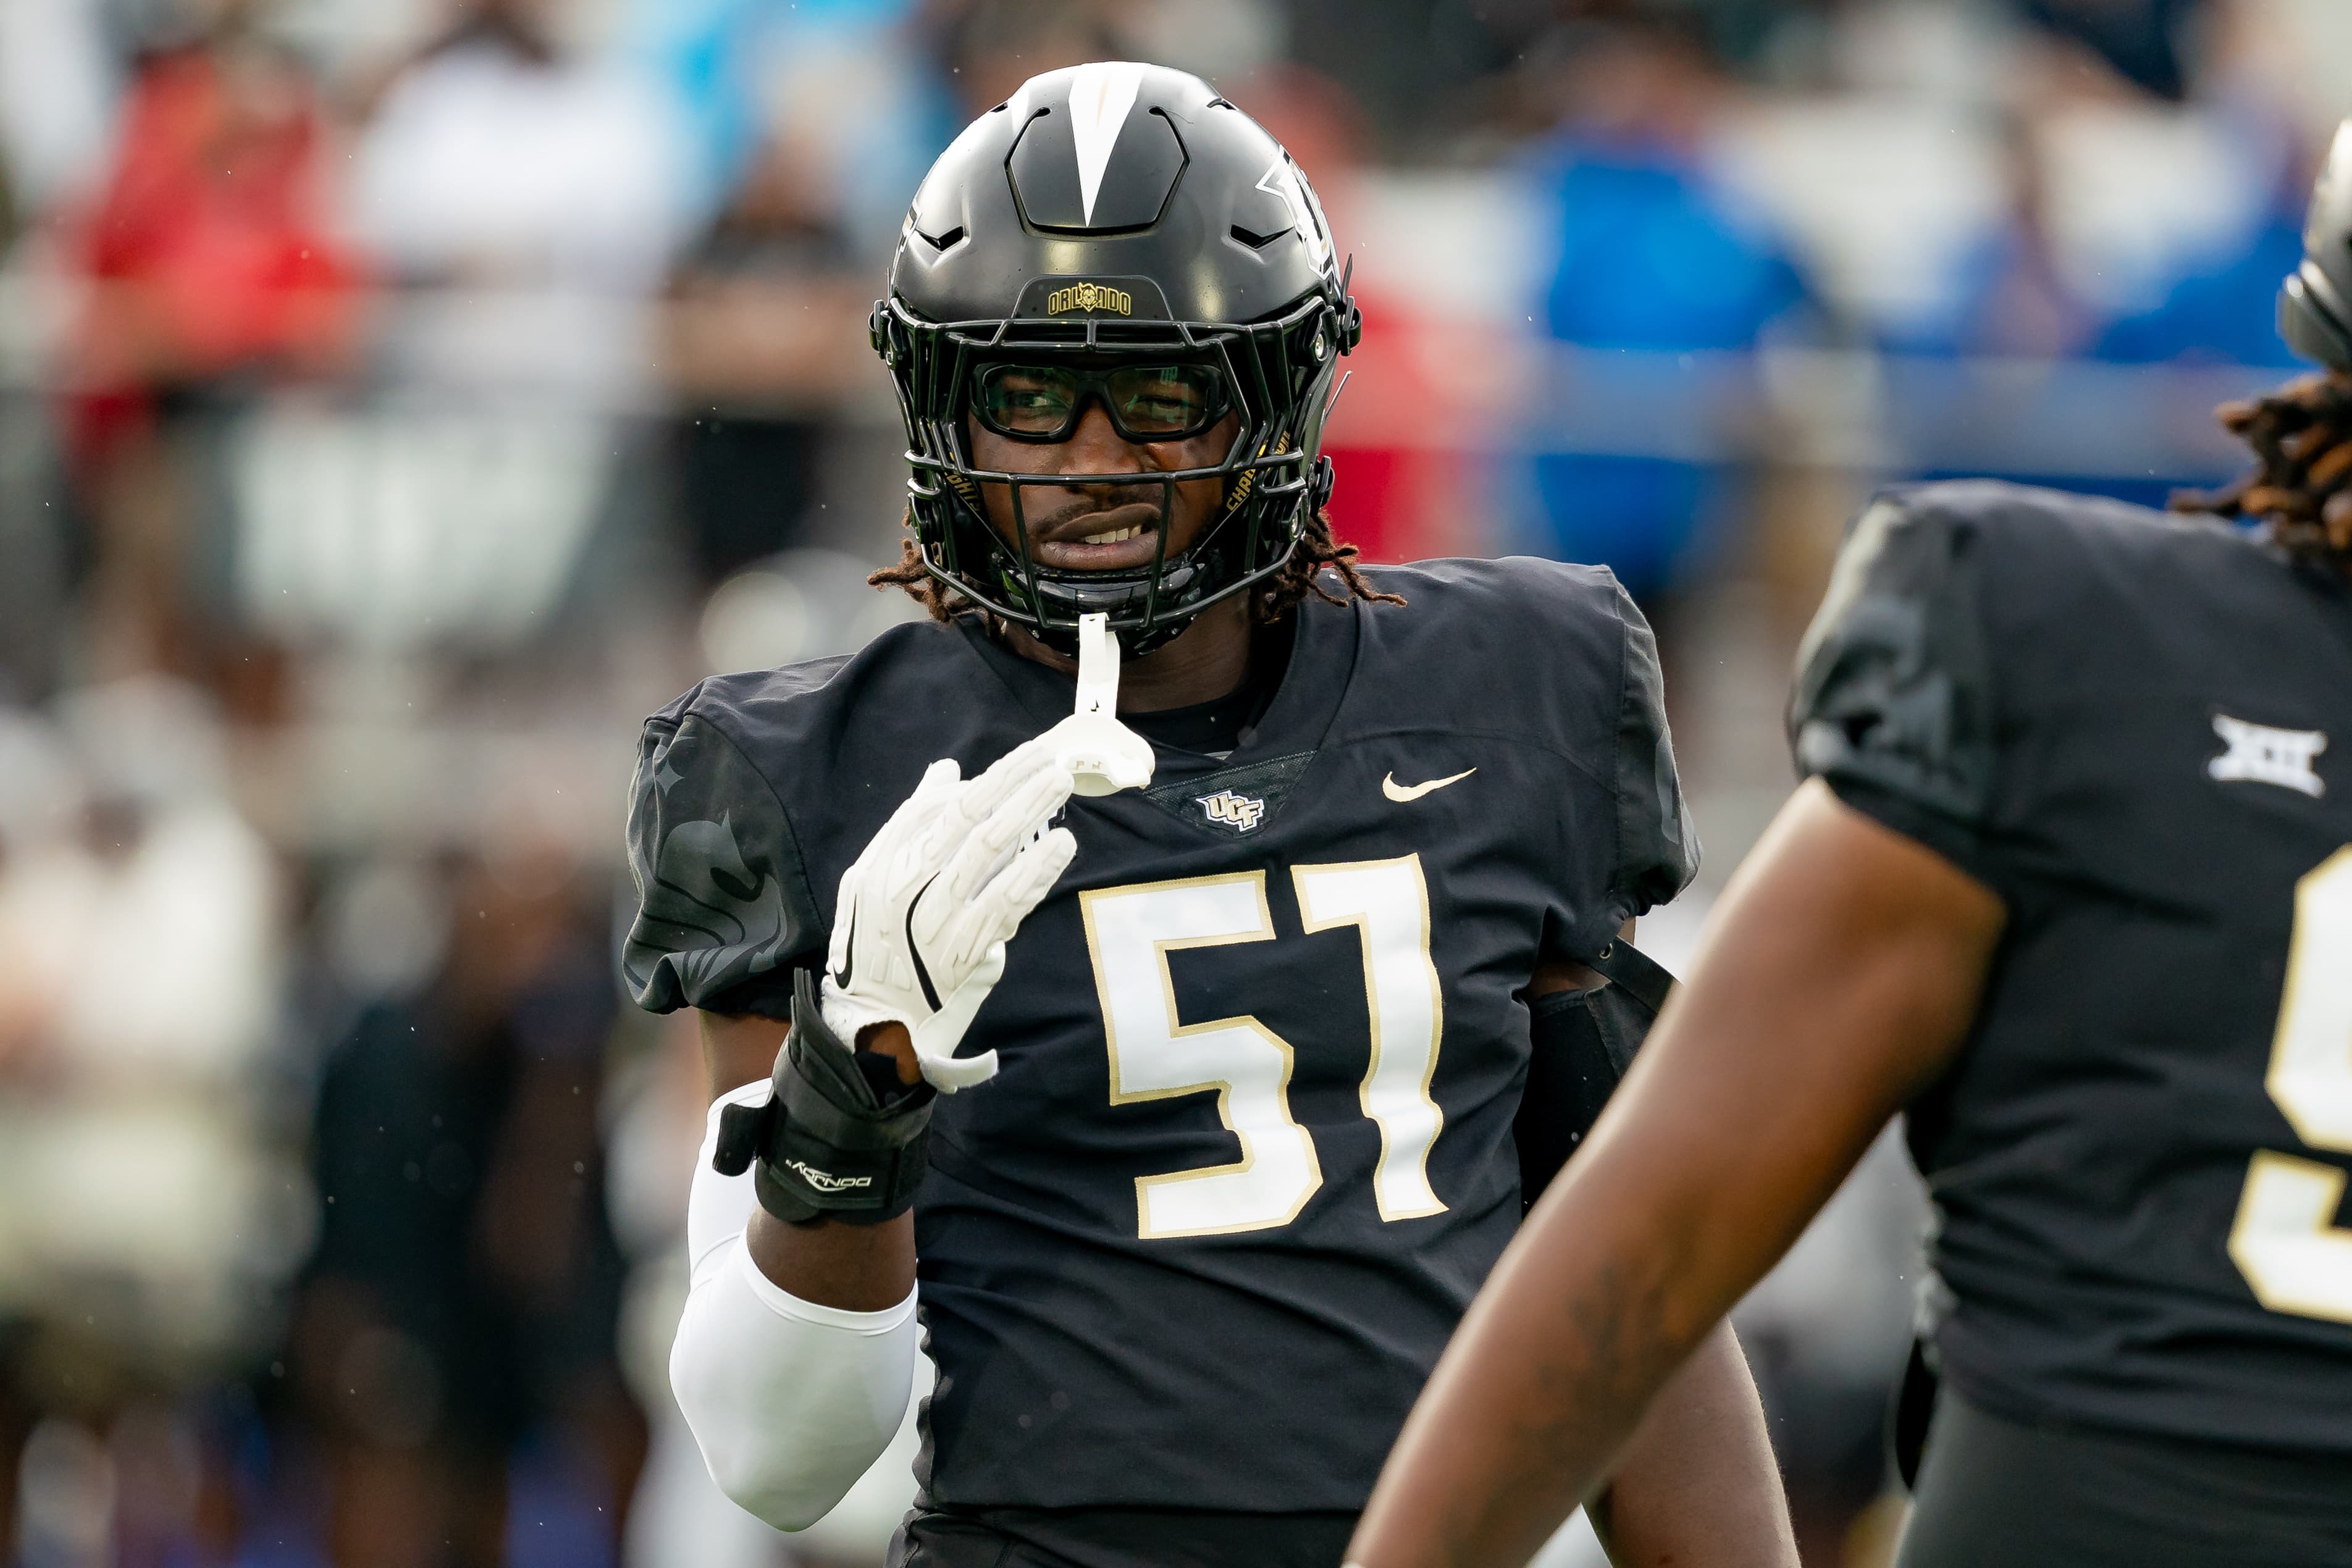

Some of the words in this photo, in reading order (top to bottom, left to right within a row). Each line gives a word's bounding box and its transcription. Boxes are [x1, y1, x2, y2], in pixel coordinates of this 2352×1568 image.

[1197, 790, 1264, 831] UCF
[1078, 852, 1450, 1239] 51
[791, 1162, 872, 1192] DONJOY
